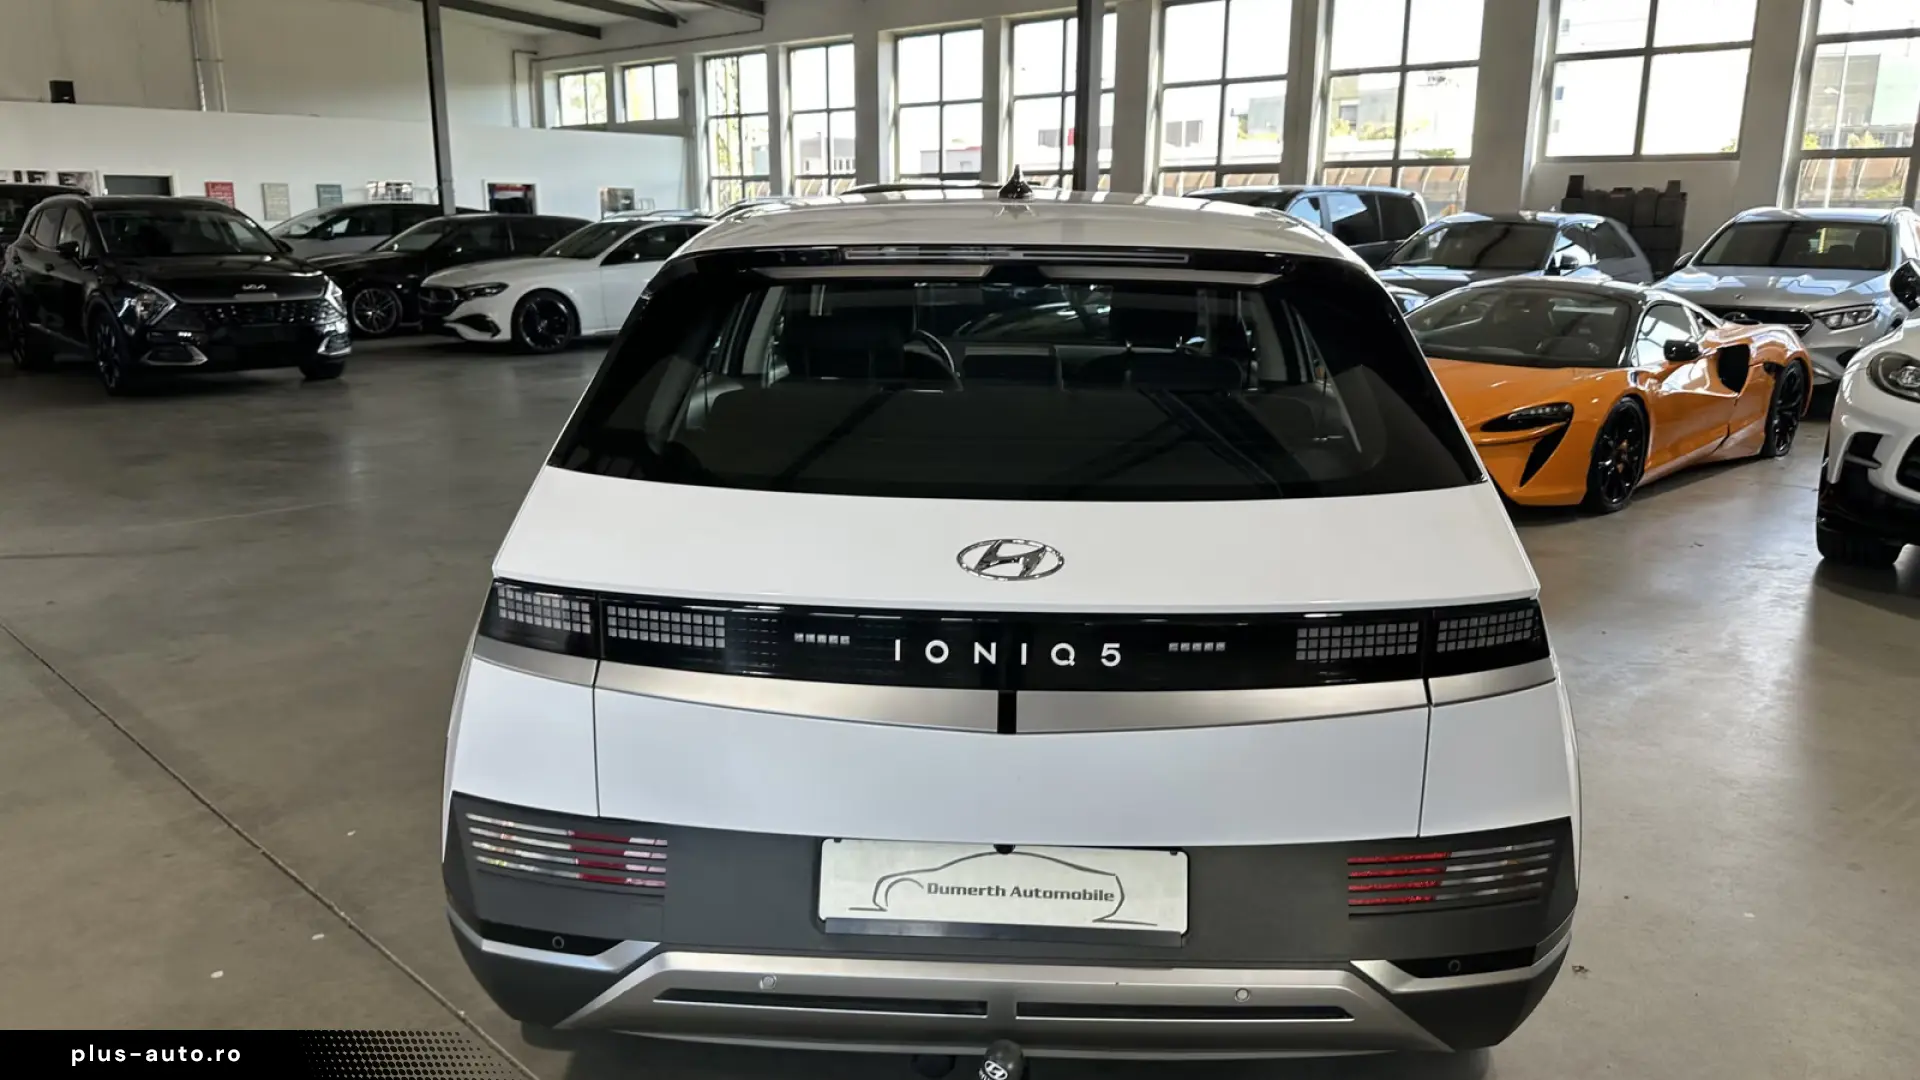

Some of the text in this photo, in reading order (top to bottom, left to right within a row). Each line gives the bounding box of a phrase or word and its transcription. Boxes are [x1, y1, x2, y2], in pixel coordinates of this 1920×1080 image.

[894, 639, 1121, 667] IONIQ 5
[927, 882, 1115, 902] Dumerth Automobile
